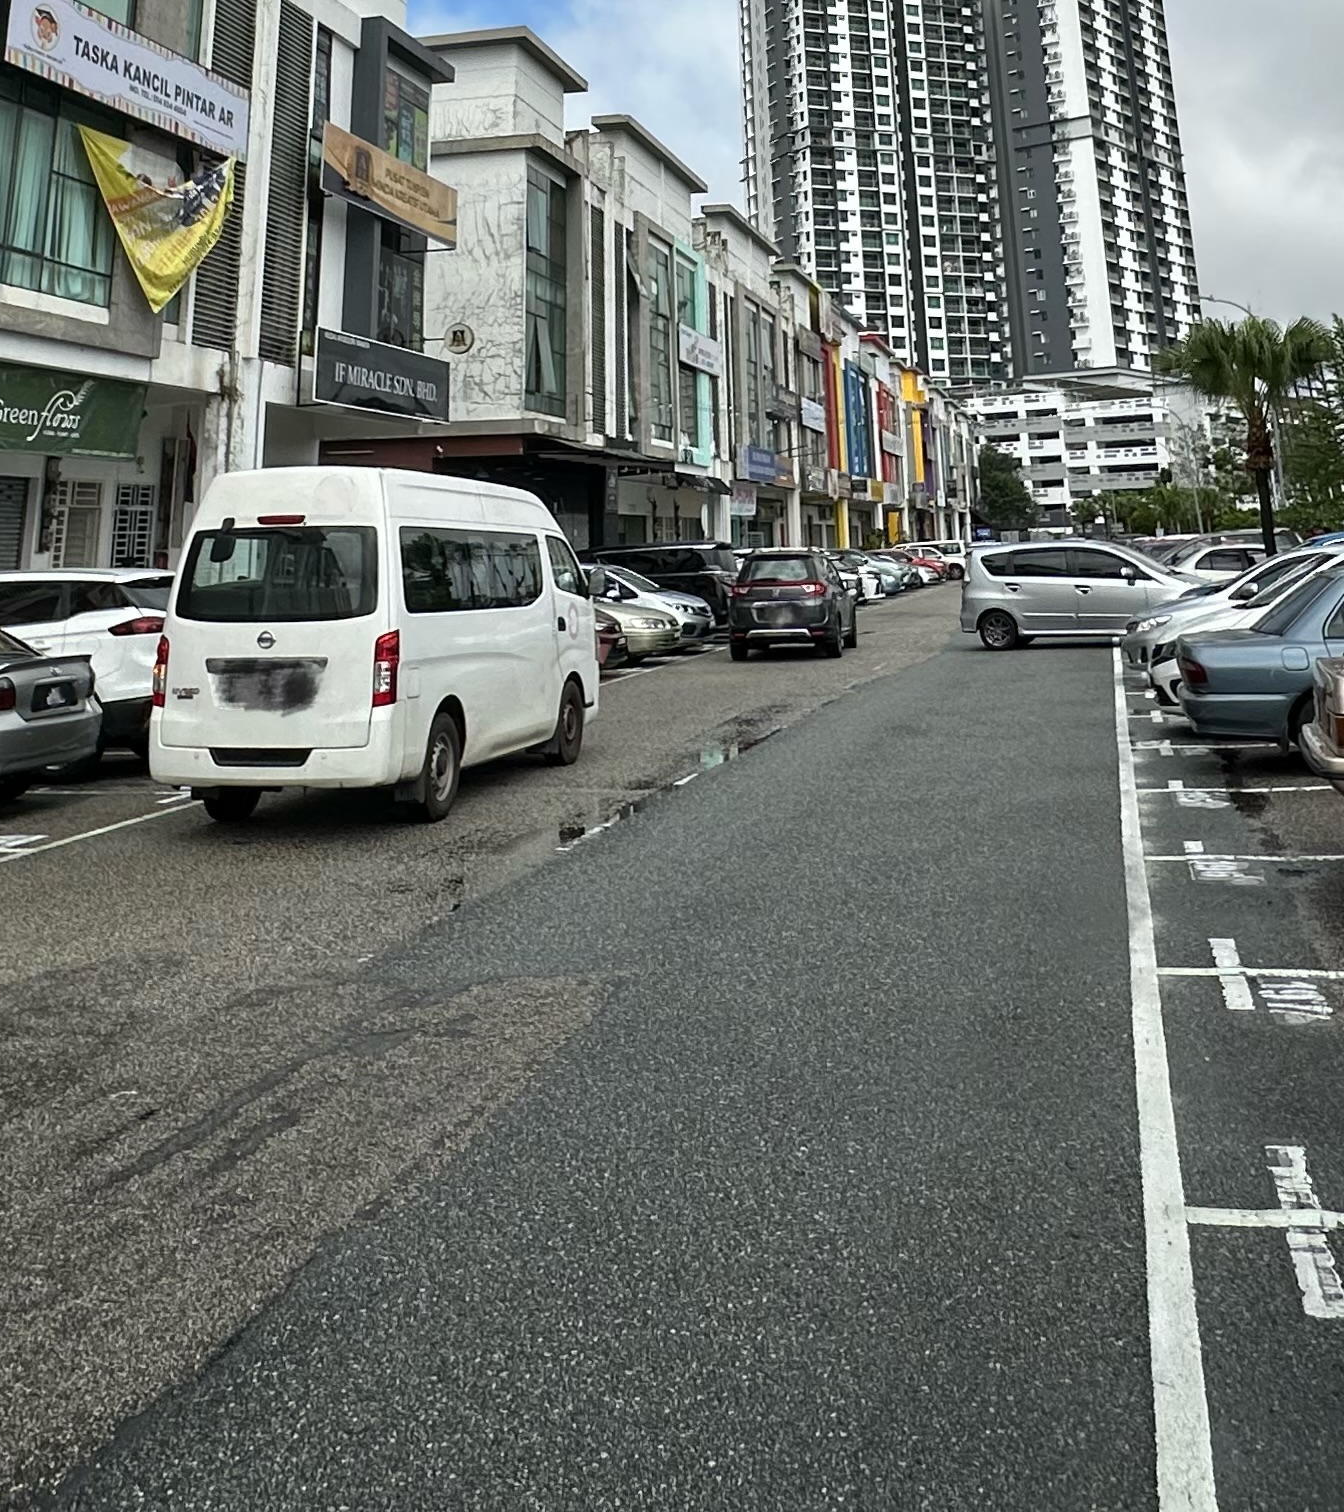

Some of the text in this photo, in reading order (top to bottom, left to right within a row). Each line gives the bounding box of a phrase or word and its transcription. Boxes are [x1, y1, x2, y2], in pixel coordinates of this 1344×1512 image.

[73, 35, 119, 75] TASKA
[123, 61, 172, 99] KANCIL
[174, 83, 216, 121] PINTAR
[218, 108, 235, 129] AR
[335, 362, 346, 383] IF
[347, 365, 392, 393] MIRACLE
[416, 381, 438, 402] BHD.
